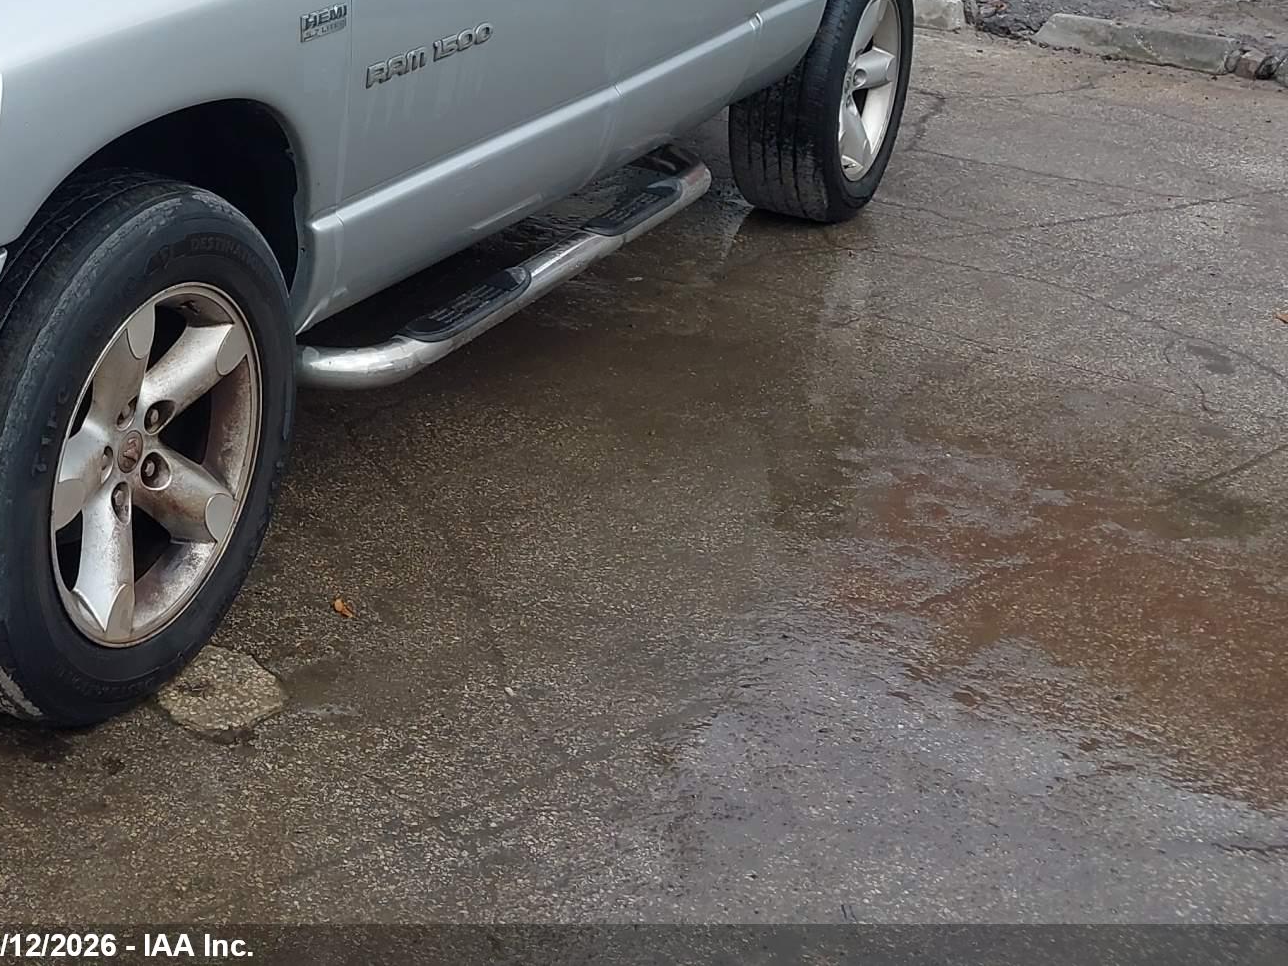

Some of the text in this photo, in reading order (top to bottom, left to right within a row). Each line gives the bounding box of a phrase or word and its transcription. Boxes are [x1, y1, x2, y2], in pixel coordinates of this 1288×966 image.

[303, 3, 348, 32] HEMI
[365, 21, 495, 90] RAM 1500
